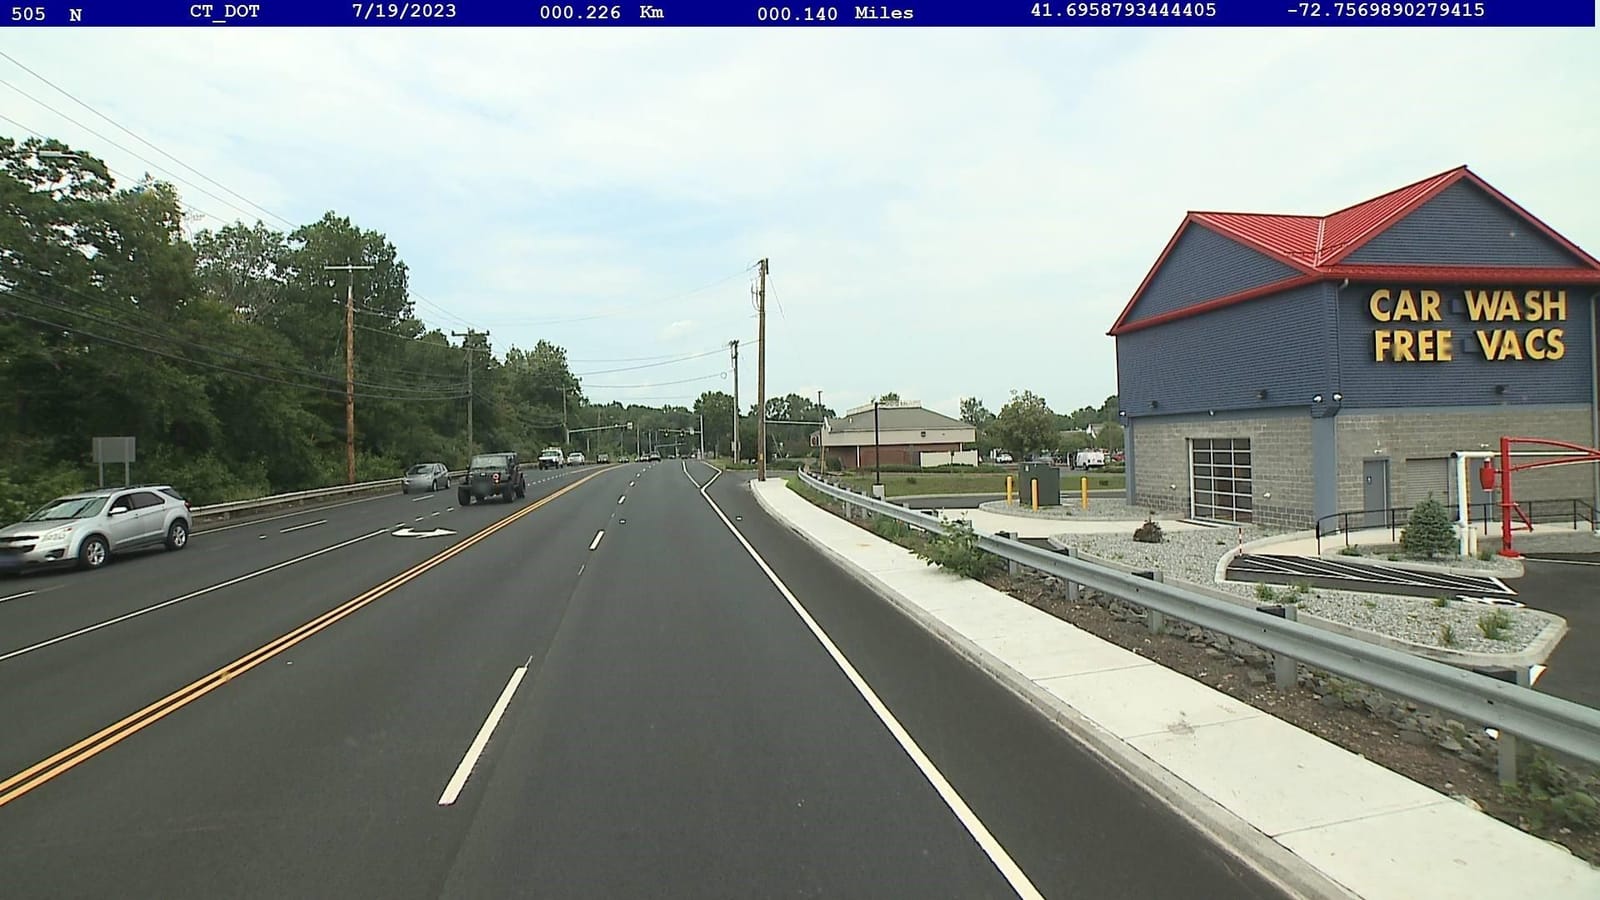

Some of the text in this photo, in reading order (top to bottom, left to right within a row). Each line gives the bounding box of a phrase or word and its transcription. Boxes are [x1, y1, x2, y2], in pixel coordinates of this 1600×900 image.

[1369, 289, 1567, 322] CAR WASH
[1374, 328, 1565, 362] FREE VACS
